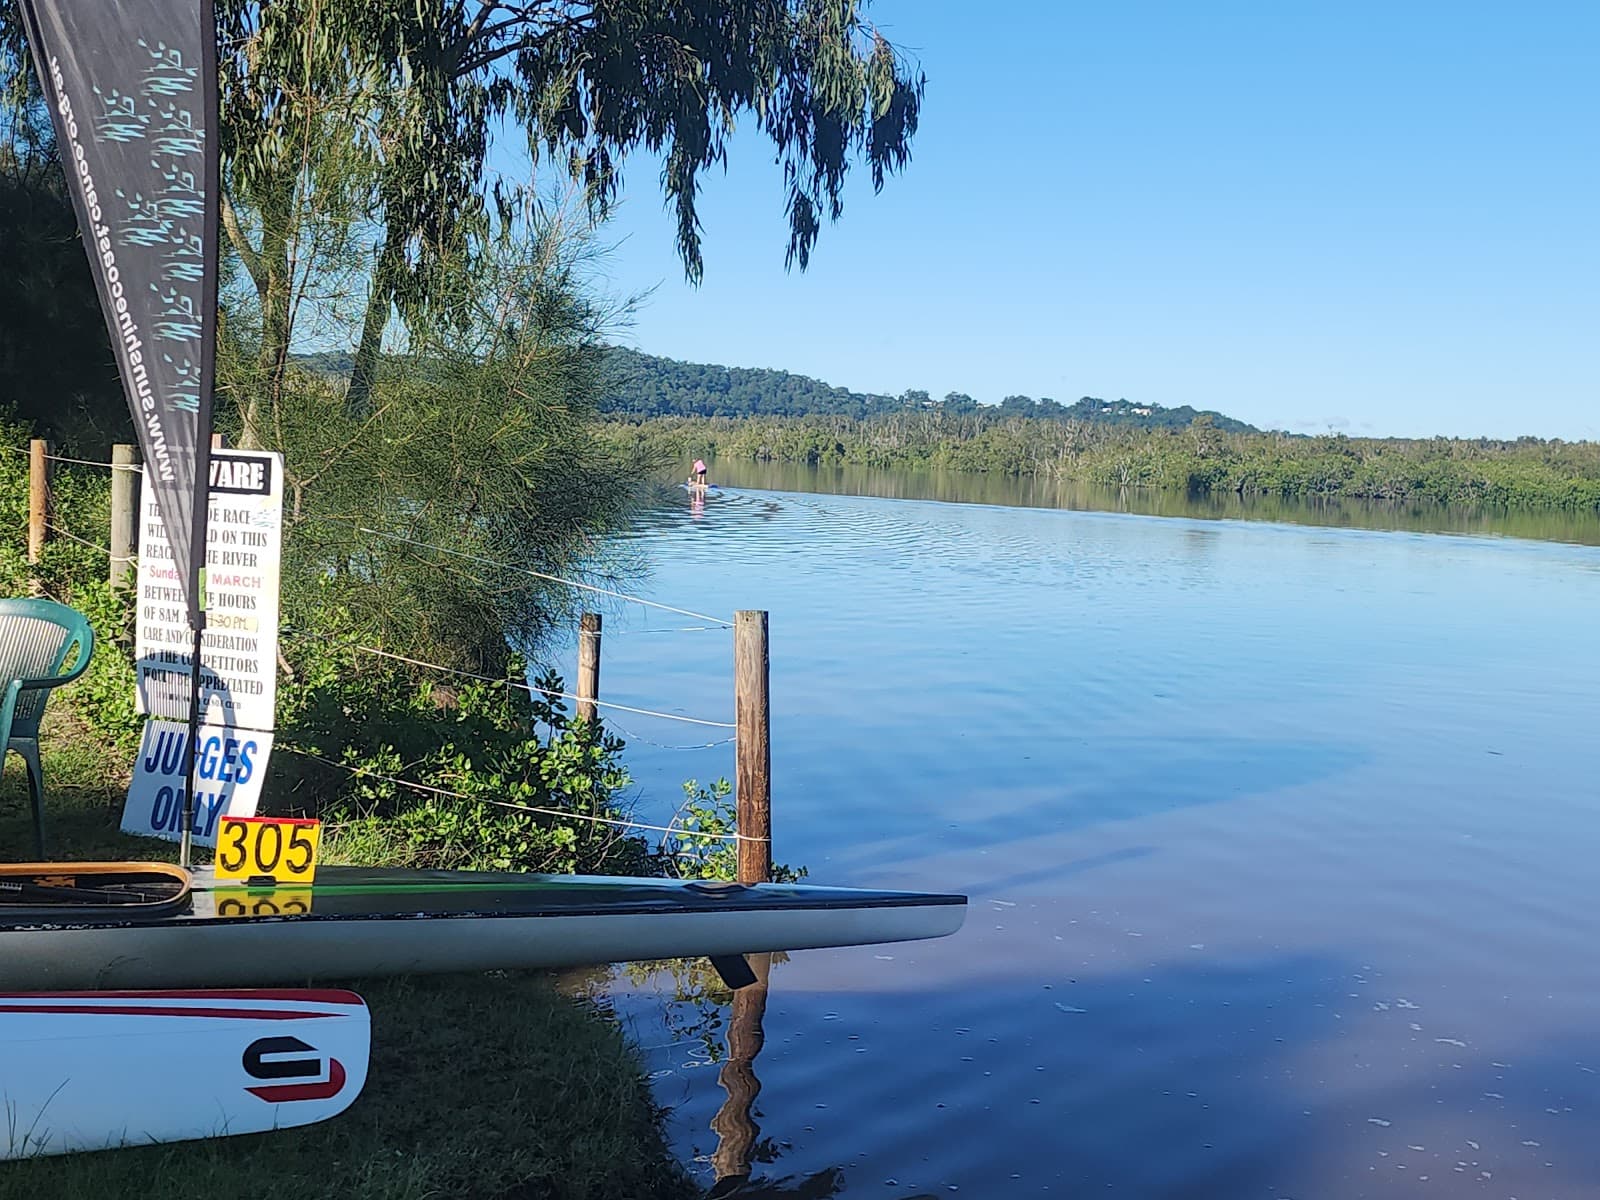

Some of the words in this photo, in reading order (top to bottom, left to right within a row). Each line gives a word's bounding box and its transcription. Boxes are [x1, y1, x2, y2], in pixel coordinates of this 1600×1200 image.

[223, 508, 251, 524] RACE
[147, 523, 167, 538] WIL
[222, 529, 237, 544] ON
[241, 531, 268, 547] THIS
[222, 551, 258, 567] RIVER
[149, 565, 182, 580] Sunda
[212, 573, 261, 588] MARCH
[144, 585, 185, 603] BETWEE
[218, 593, 257, 610] HOURS
[144, 606, 156, 620] OF
[159, 608, 179, 623] 8AM
[143, 626, 163, 643] CARE
[165, 628, 182, 644] AND
[185, 630, 258, 652] COSIDERATION
[143, 646, 156, 661] TO
[159, 649, 178, 664] THE
[181, 651, 259, 673] COPETITORS
[199, 674, 263, 695] PPRECIATED
[151, 786, 226, 837] ONLY
[220, 821, 314, 874] 305
